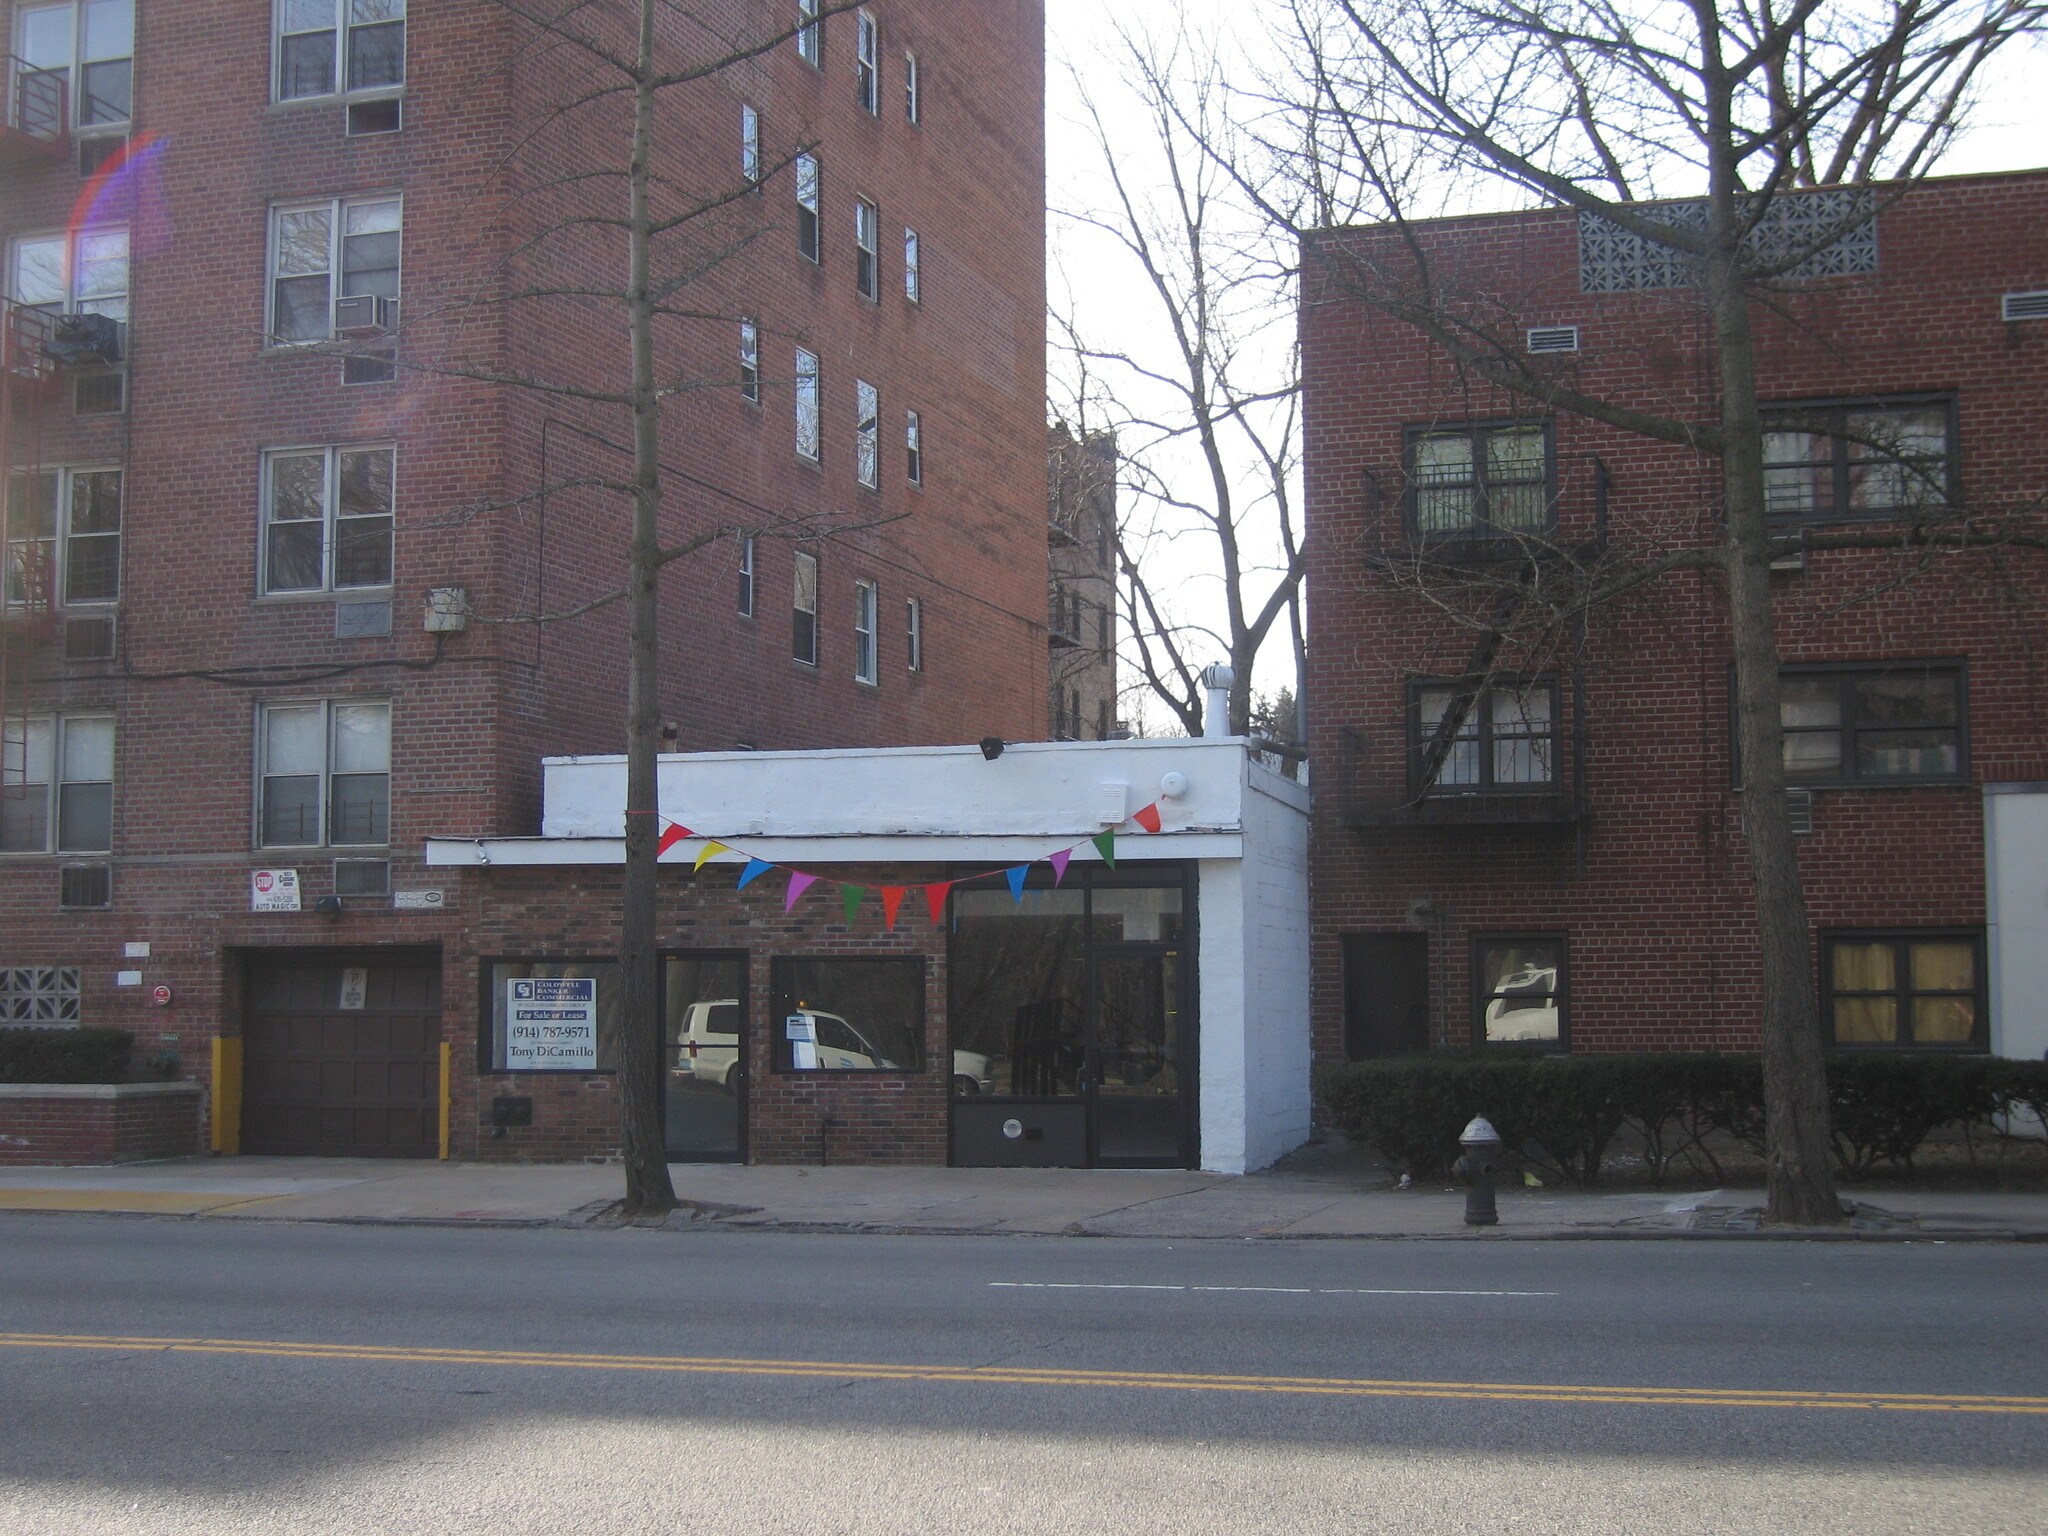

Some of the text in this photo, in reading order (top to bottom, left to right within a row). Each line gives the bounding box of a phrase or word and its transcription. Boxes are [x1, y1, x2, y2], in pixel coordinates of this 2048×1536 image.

[257, 877, 272, 888] STOP
[513, 1026, 590, 1039] (914) 787-9571
[510, 1046, 594, 1059] Tony DiCamillo
